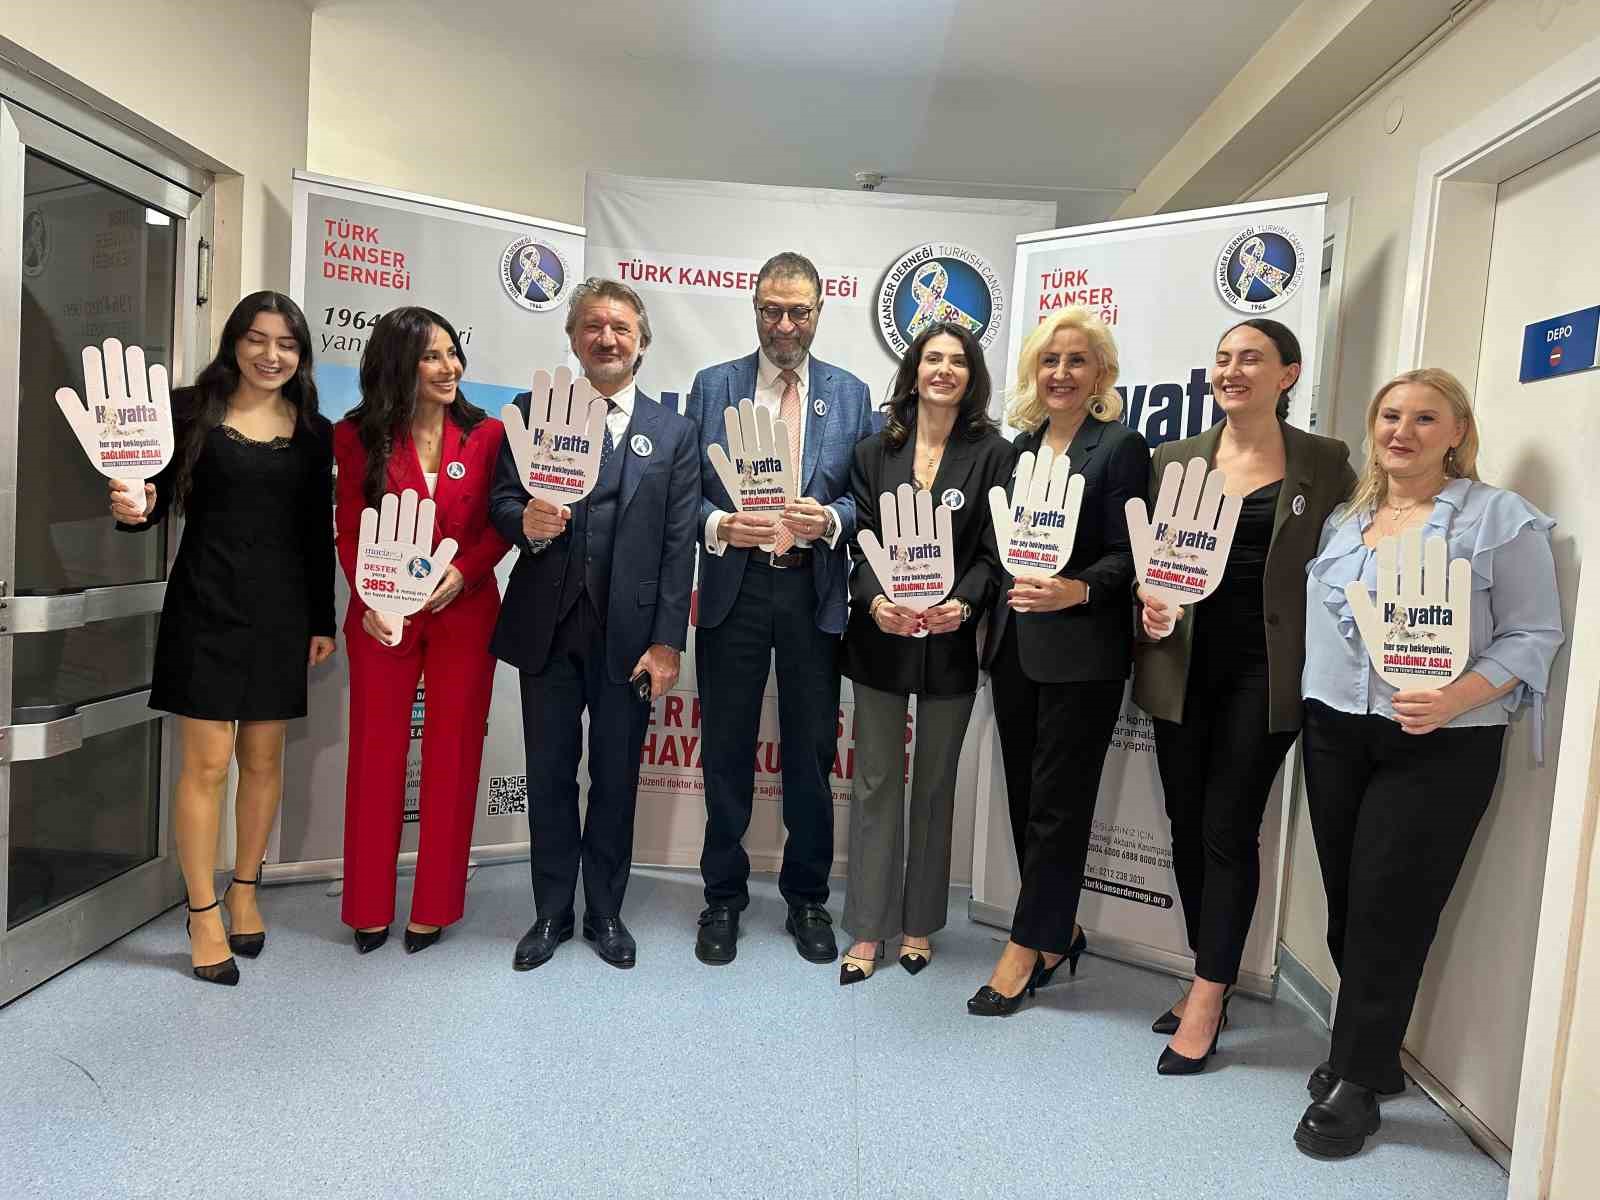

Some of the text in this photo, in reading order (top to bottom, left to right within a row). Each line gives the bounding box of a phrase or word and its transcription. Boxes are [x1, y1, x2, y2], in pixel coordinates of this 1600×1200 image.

[325, 218, 379, 244] TÜRK
[324, 240, 405, 268] KANSER
[323, 262, 411, 290] DERNEĞİ
[618, 258, 673, 283] TÜRK
[1040, 268, 1088, 291] TÜRK
[882, 245, 934, 354] ÜRK KANSER DERNEĞİ
[937, 246, 1004, 350] TURKISH CANCER SOCIE
[1039, 287, 1113, 311] KANSER
[1223, 288, 1239, 304] TÜRK
[1547, 325, 1572, 342] DEPO
[566, 479, 584, 488] ASLA!
[364, 563, 398, 574] DESTEK
[1161, 560, 1171, 568] şey
[362, 578, 395, 592] 3853
[1147, 568, 1185, 584] SAĞLIĞINIZ
[1185, 576, 1206, 588] ASLA!
[1384, 655, 1452, 668] SAĞLIĞINIZ ASLA!
[666, 779, 692, 790] doktor
[1121, 851, 1138, 862] 6888
[1139, 855, 1156, 866] 8000
[1082, 879, 1166, 907] .turkkanserdernegi.org
